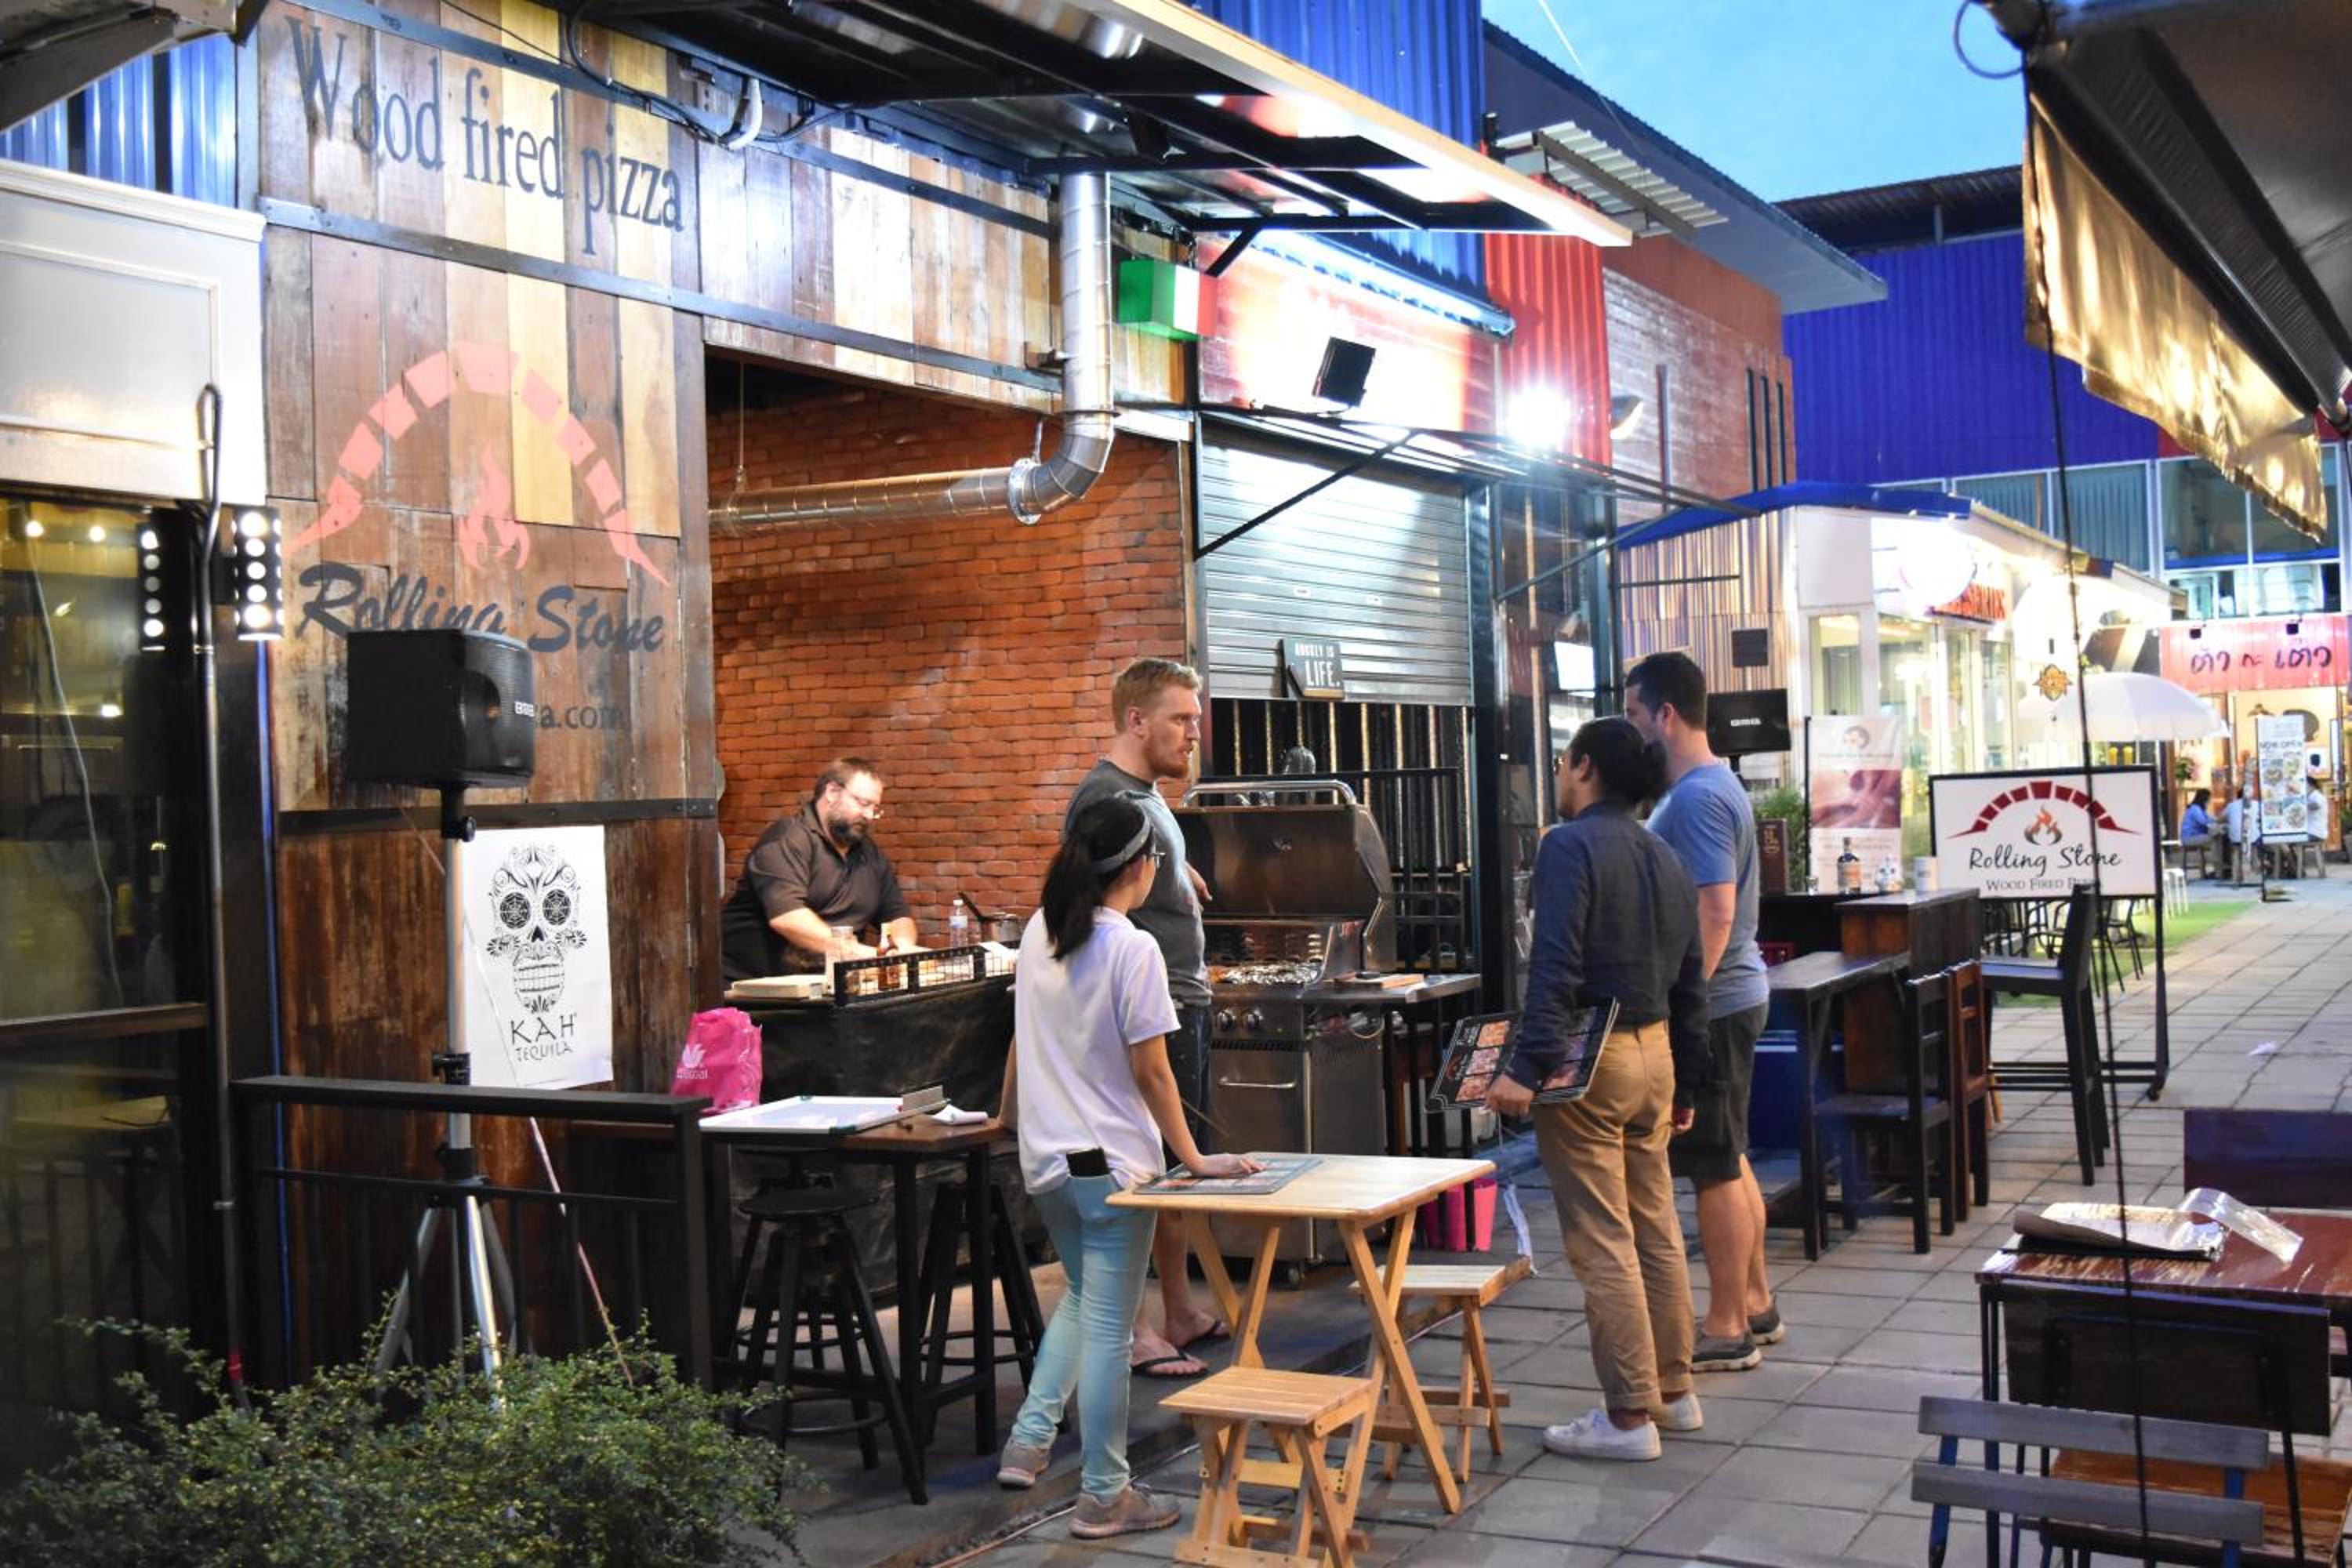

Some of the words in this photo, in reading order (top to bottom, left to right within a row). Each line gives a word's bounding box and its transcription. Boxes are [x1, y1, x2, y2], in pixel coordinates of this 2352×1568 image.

[284, 14, 445, 171] Wood
[460, 67, 566, 201] fired
[580, 123, 684, 256] pizza
[527, 584, 666, 654] Stone
[1305, 660, 1341, 688] LIFE.
[1969, 843, 2047, 877] Rolling
[2057, 843, 2122, 869] Stone
[510, 1014, 573, 1045] KAH
[515, 1041, 574, 1062] TEQUILA
